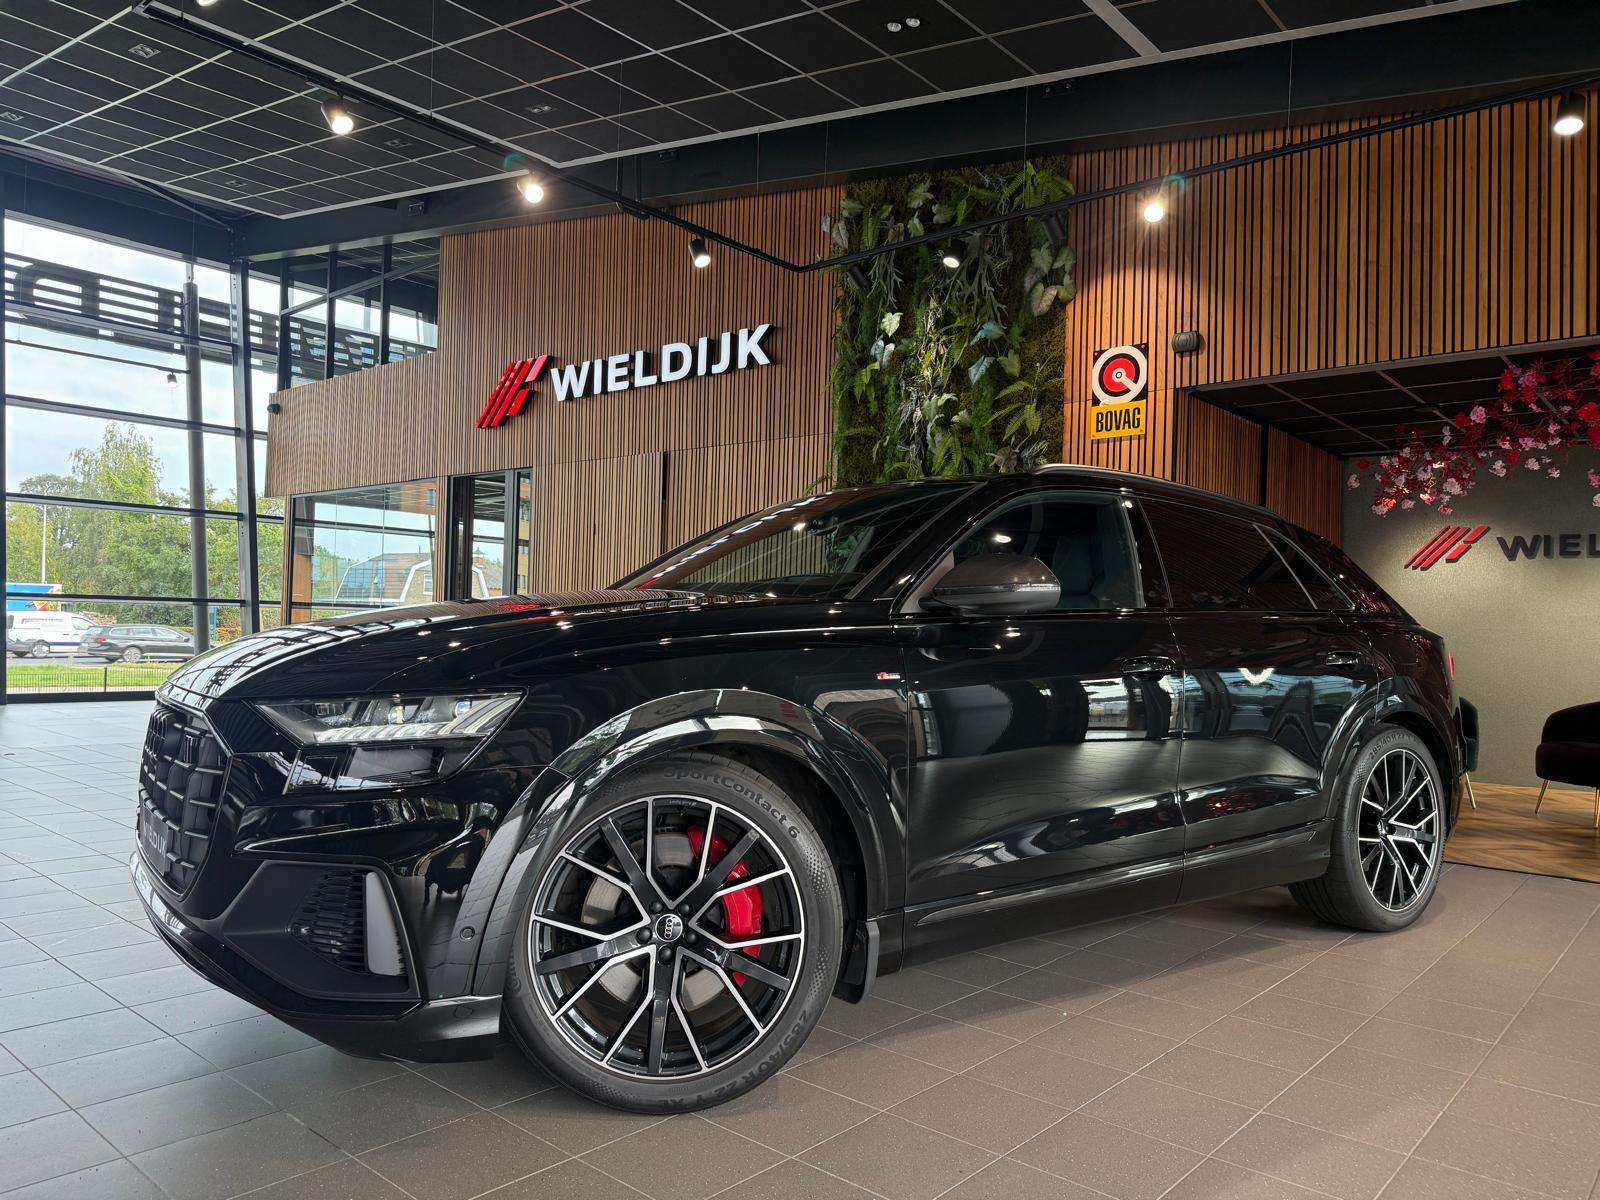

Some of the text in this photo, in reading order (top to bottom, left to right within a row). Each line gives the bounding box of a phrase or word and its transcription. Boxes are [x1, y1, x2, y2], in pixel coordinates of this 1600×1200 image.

[549, 323, 773, 402] WIELDIJK
[1095, 406, 1141, 433] BOVAG
[1496, 533, 1600, 562] WIEL
[663, 766, 801, 839] SportContact 6
